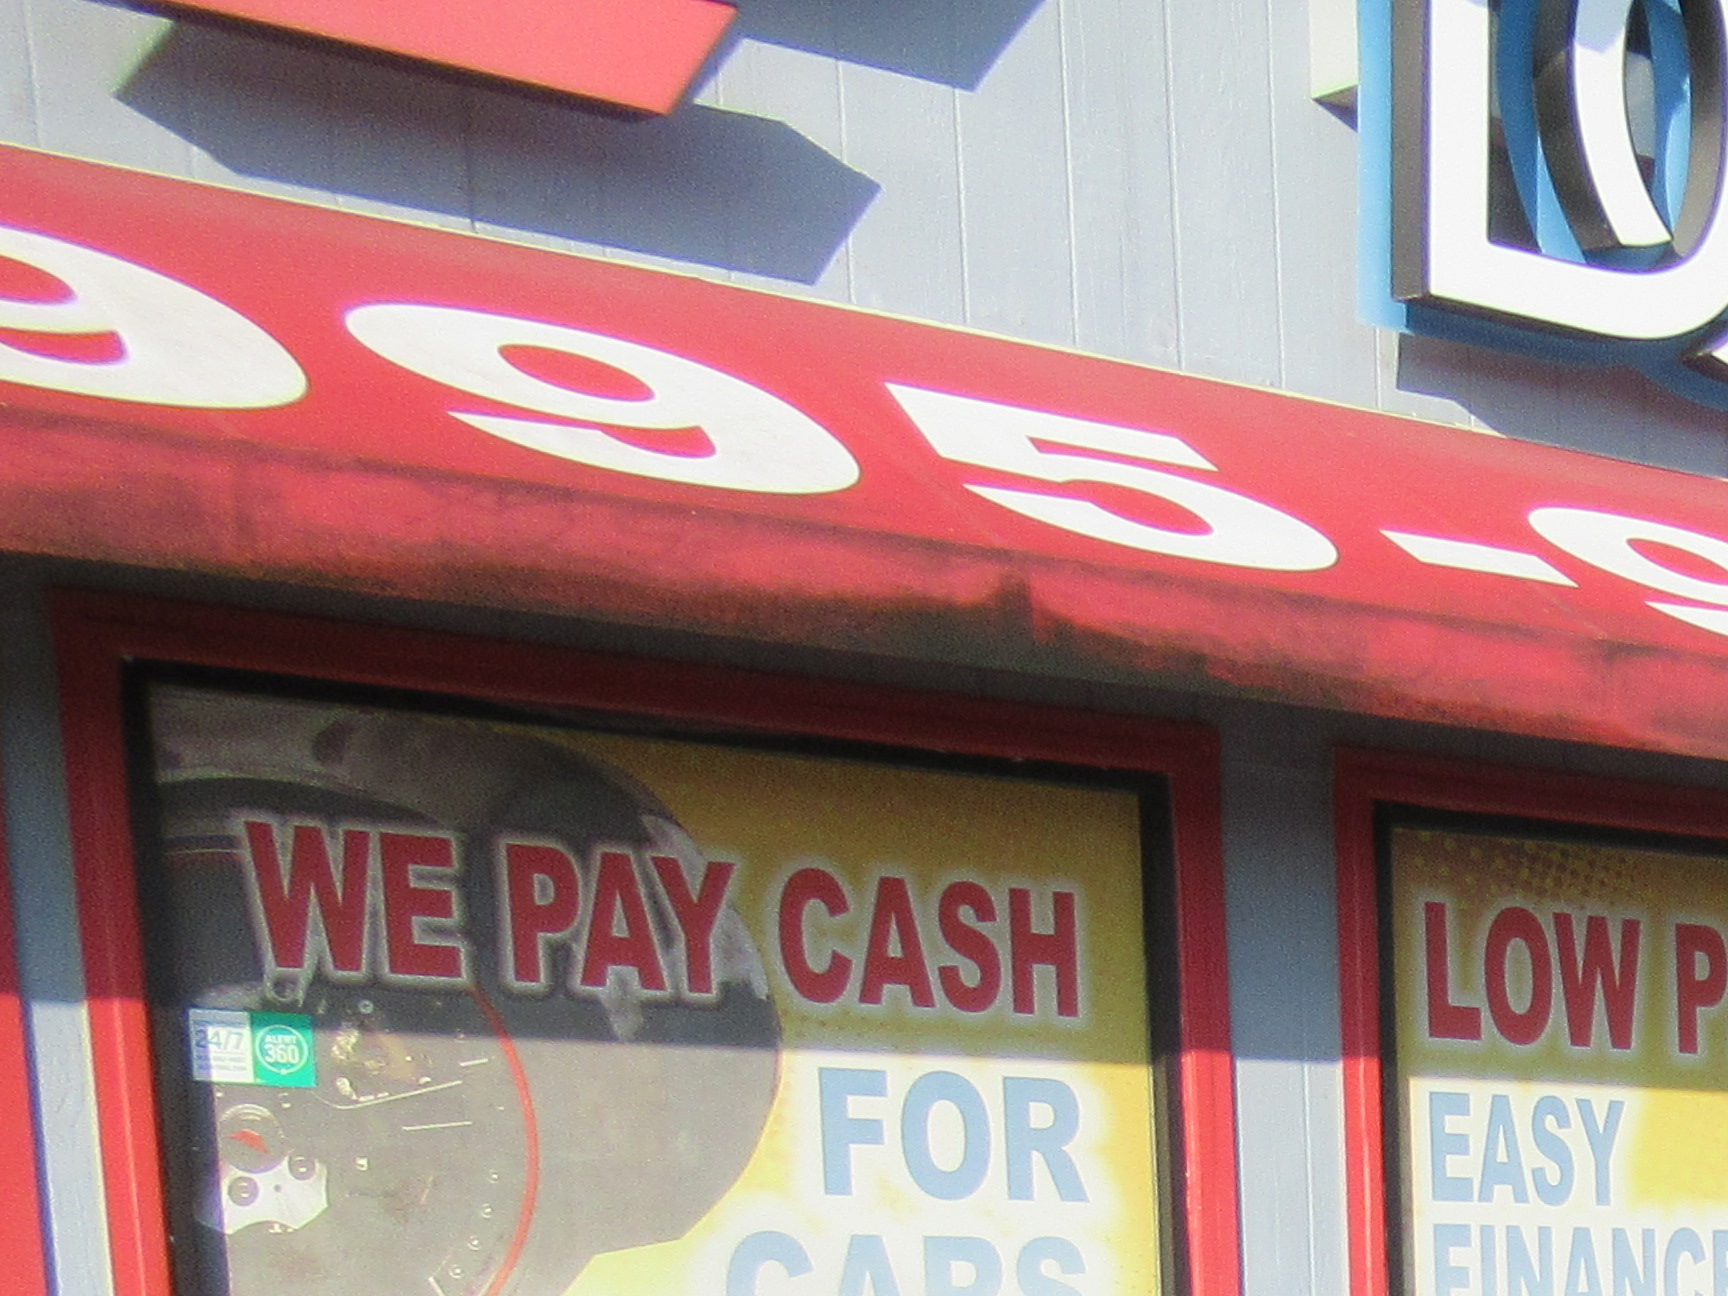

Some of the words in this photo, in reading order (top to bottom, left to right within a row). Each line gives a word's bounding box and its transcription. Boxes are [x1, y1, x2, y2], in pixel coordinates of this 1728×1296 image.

[241, 819, 467, 983] WE
[504, 841, 735, 997] PAY
[776, 866, 1081, 1019] CASH
[1423, 900, 1642, 1052] LOW
[263, 1043, 300, 1065] 360
[815, 1065, 1090, 1204] FOR
[1427, 1091, 1625, 1207] EASY
